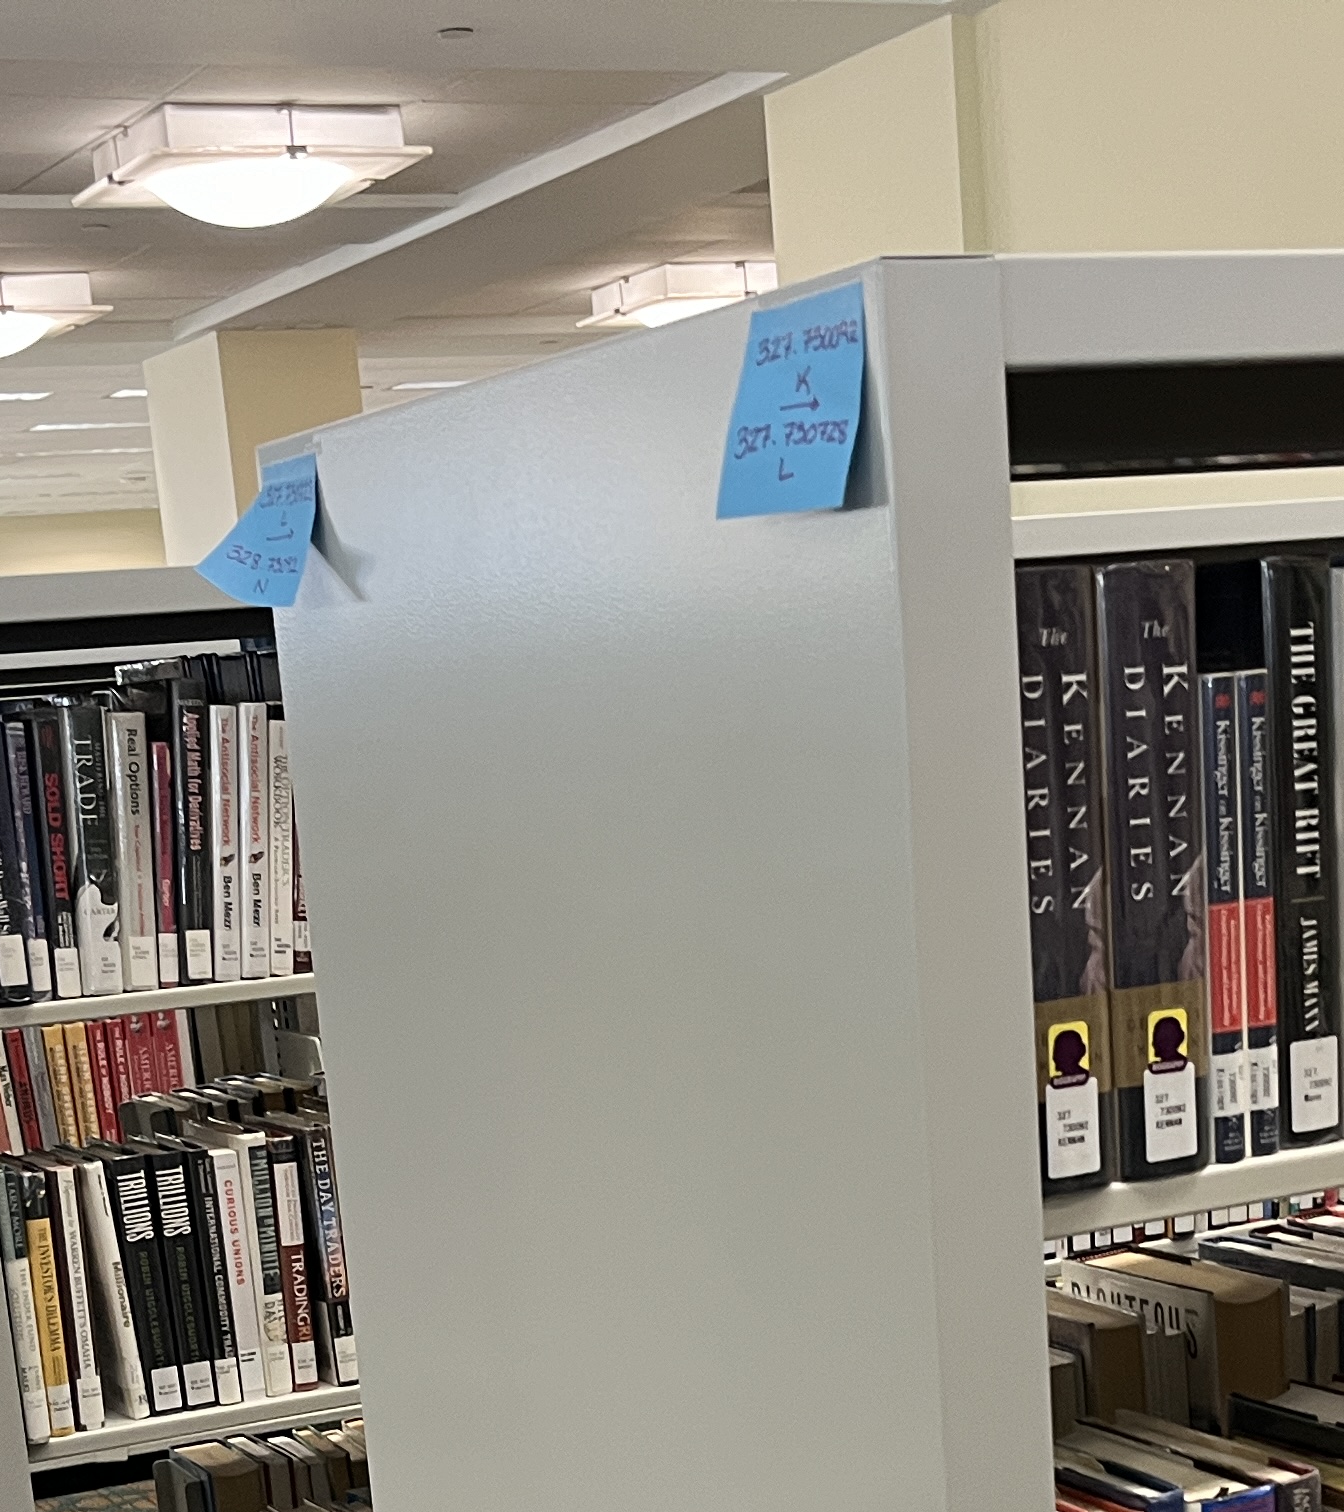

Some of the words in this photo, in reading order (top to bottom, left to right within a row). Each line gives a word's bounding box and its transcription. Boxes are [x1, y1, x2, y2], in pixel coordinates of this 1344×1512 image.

[796, 365, 812, 395] K
[778, 457, 794, 481] L
[1288, 622, 1316, 683] THE
[125, 727, 139, 756] Real
[182, 708, 201, 749] Applied
[220, 717, 229, 733] The
[1289, 695, 1319, 794] GREAT
[71, 735, 100, 827] TRADE
[125, 760, 143, 815] Options
[186, 751, 200, 776] Math
[187, 778, 201, 793] for
[220, 736, 231, 794] Antisocial
[250, 734, 260, 792] Antisocial
[1061, 671, 1090, 909] KENNAN
[1124, 666, 1153, 900] DIARIES
[1162, 664, 1191, 897] KENNAN
[43, 771, 63, 827] SOLD
[187, 794, 204, 850] Derivatives
[221, 799, 231, 845] Network
[250, 796, 261, 843] Network
[1022, 675, 1053, 914] DIARIES
[48, 832, 69, 901] SHORT
[1294, 809, 1321, 878] RIFT
[222, 875, 232, 898] Ben
[252, 873, 261, 894] Ben
[1299, 918, 1319, 976] JAMES
[1301, 981, 1321, 1032] MANN
[310, 1138, 329, 1174] THE
[114, 1169, 156, 1243] TRILLIONS
[152, 1165, 193, 1238] TRILLIONS
[223, 1178, 239, 1234] CURIOUS
[250, 1158, 272, 1217] MILLION
[316, 1179, 334, 1213] DAY
[203, 1195, 222, 1273] INTERNATIONAL
[214, 1274, 230, 1331] COMMODITY
[230, 1239, 245, 1286] UNIONS
[256, 1226, 279, 1276] MINUTE
[322, 1216, 346, 1297] TRADERS
[68, 1230, 82, 1274] WARREN
[79, 1328, 92, 1369] OMAHA
[109, 1260, 134, 1328] Millionaire
[43, 1305, 61, 1353] DILEMMA
